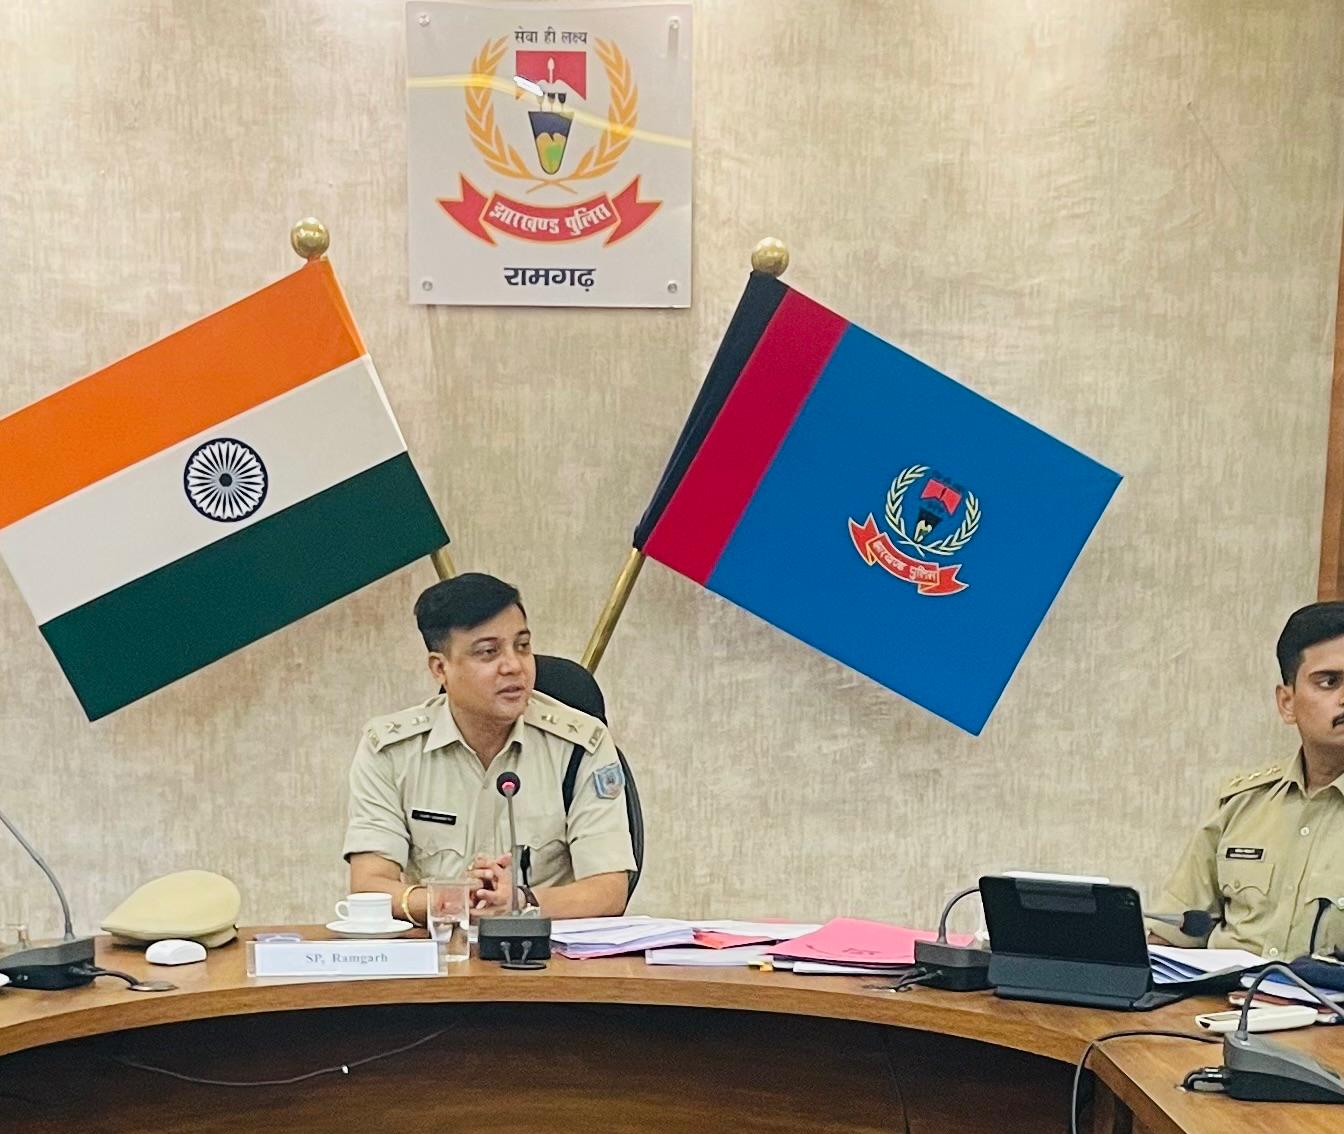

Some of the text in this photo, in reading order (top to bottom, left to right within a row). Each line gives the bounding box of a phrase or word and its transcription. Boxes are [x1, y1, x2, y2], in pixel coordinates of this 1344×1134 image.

[514, 26, 588, 44] सेवा ही लक्ष्य
[564, 203, 612, 236] पुलिस
[503, 267, 597, 292] रामगढ़
[332, 953, 388, 964] Ramgarh
